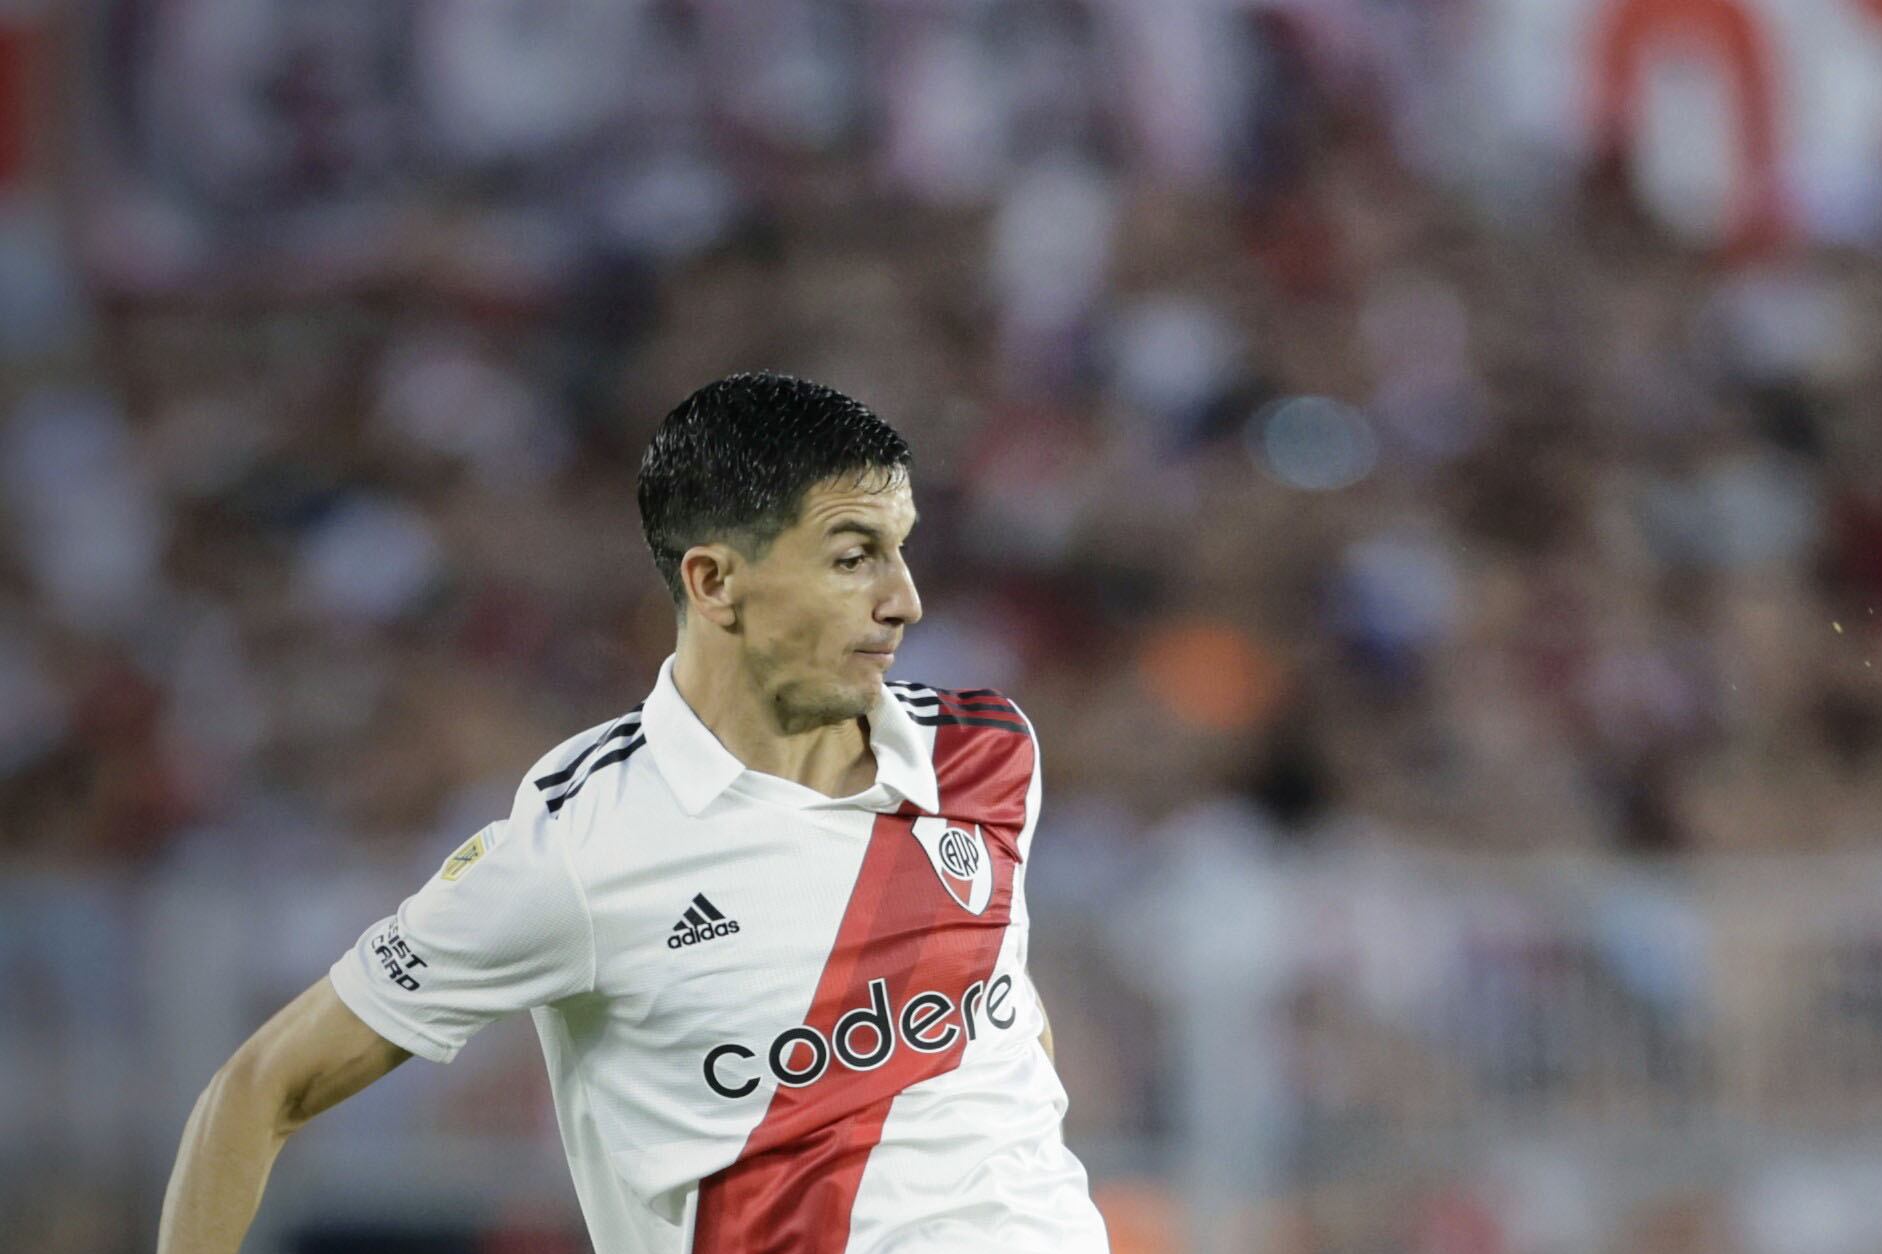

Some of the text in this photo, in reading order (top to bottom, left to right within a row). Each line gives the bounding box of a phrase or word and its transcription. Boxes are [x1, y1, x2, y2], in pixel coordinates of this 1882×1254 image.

[371, 934, 420, 992] CARD
[667, 919, 741, 950] adidas
[702, 972, 1017, 1100] codere
